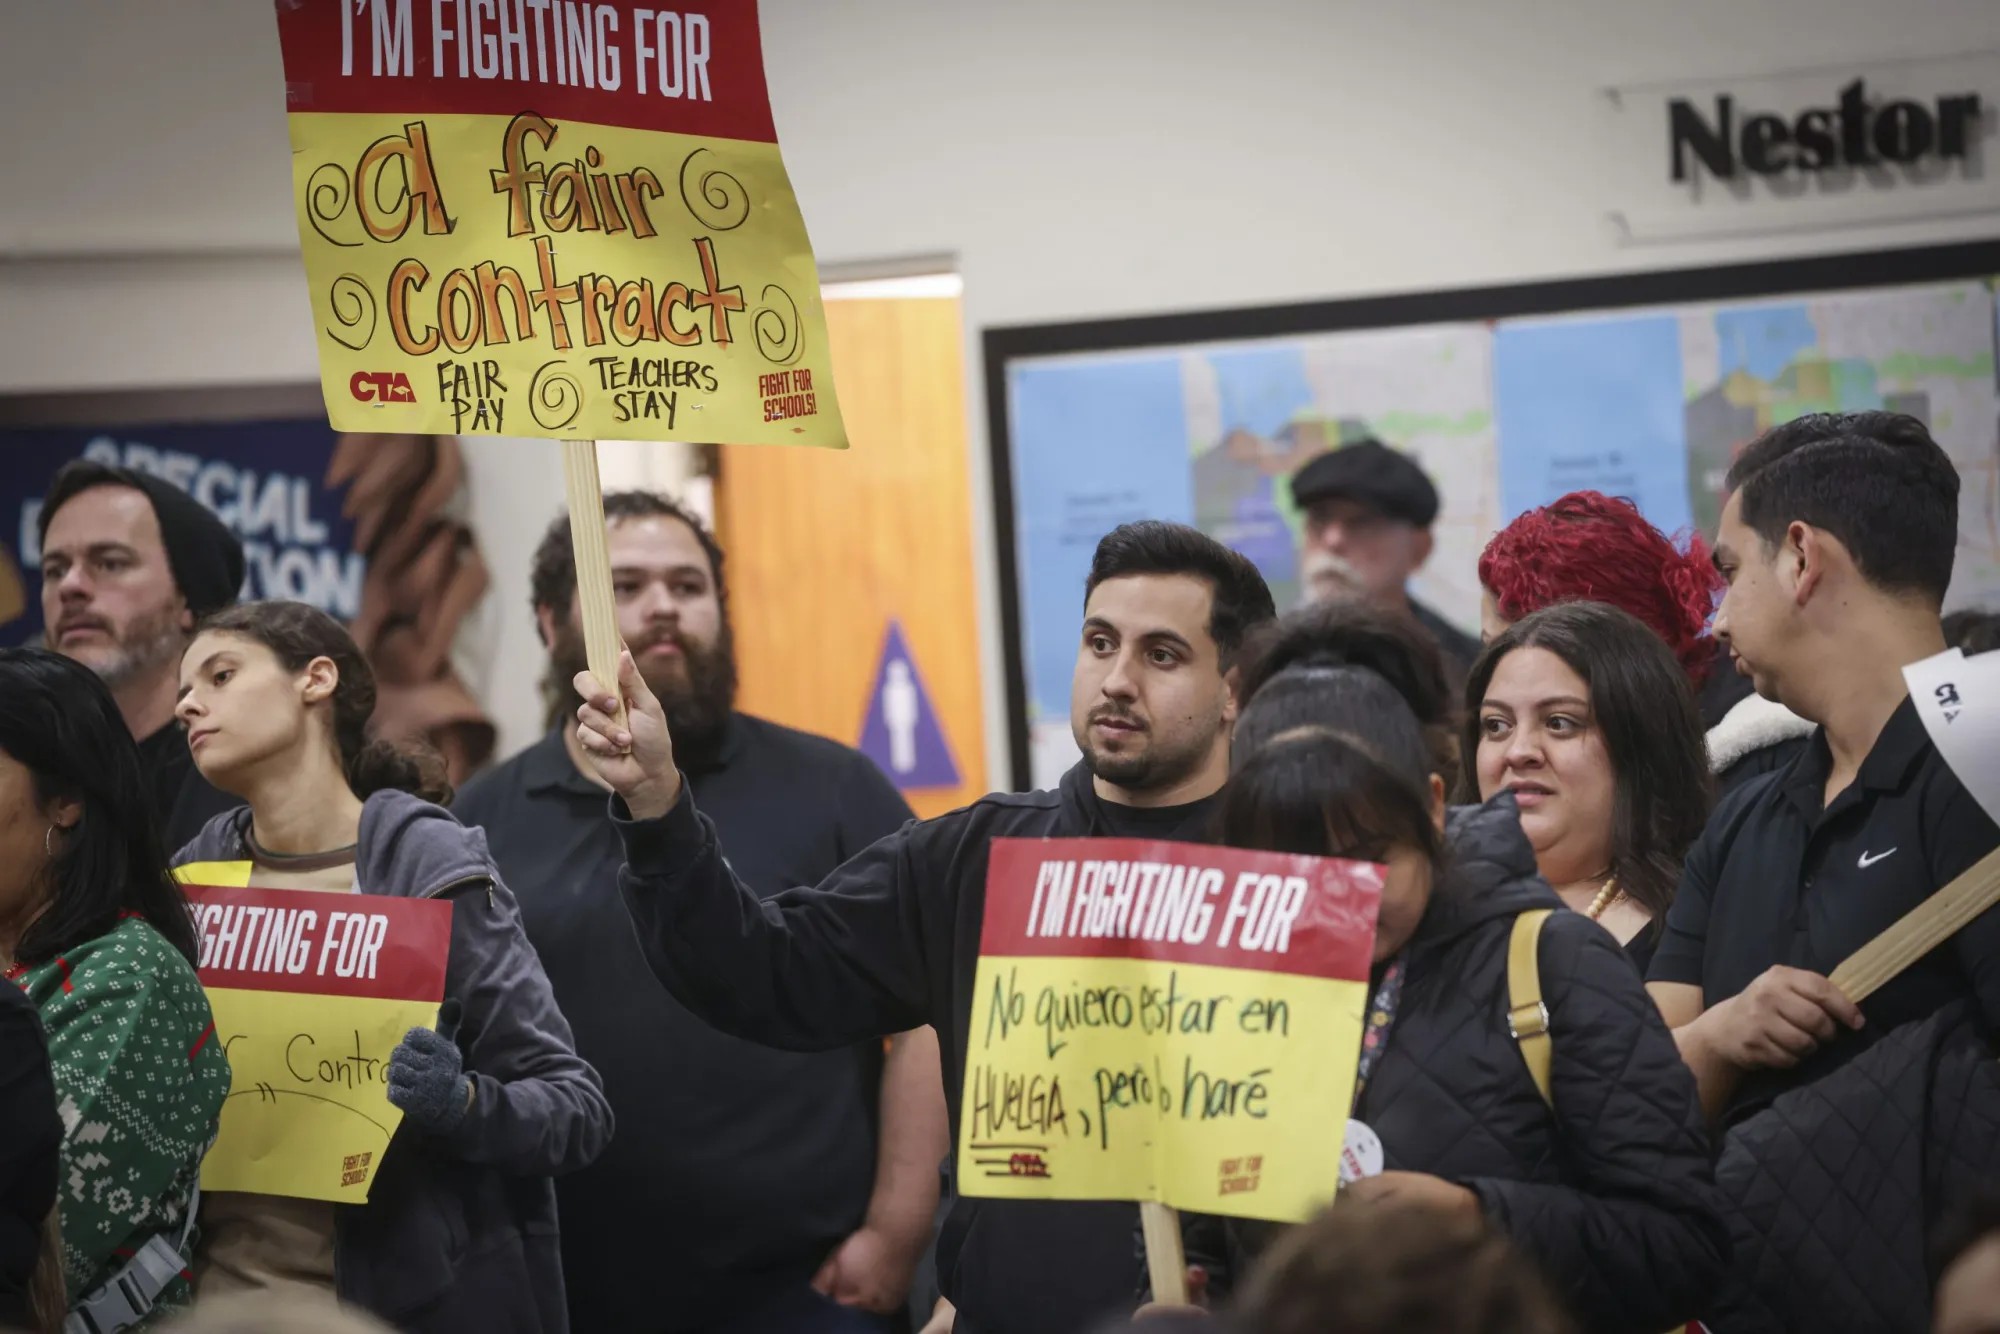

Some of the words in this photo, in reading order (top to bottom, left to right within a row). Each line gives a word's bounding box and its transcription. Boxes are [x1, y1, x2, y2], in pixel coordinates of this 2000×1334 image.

[340, 0, 414, 77] I'M
[431, 0, 621, 92] FIGHTING
[632, 10, 712, 102] FOR
[1669, 78, 1980, 181] Nestor
[490, 110, 664, 240] fair
[349, 371, 417, 403] CTA
[437, 359, 508, 403] FAIR
[589, 356, 719, 392] TEACHERS
[758, 371, 790, 398] FIGHT
[792, 368, 813, 392] FOR
[450, 397, 504, 434] PAY
[612, 390, 677, 430] STAY
[763, 392, 818, 423] SCHOOLS!
[1026, 860, 1077, 938] I'M
[1068, 860, 1225, 945] FIGHTING
[1216, 871, 1308, 954] FOR
[196, 904, 318, 975] GHTING
[316, 911, 389, 979] FOR
[985, 966, 1024, 1050] No
[1035, 980, 1133, 1060] quiero
[1139, 970, 1232, 1035] estar
[1239, 998, 1289, 1037] en
